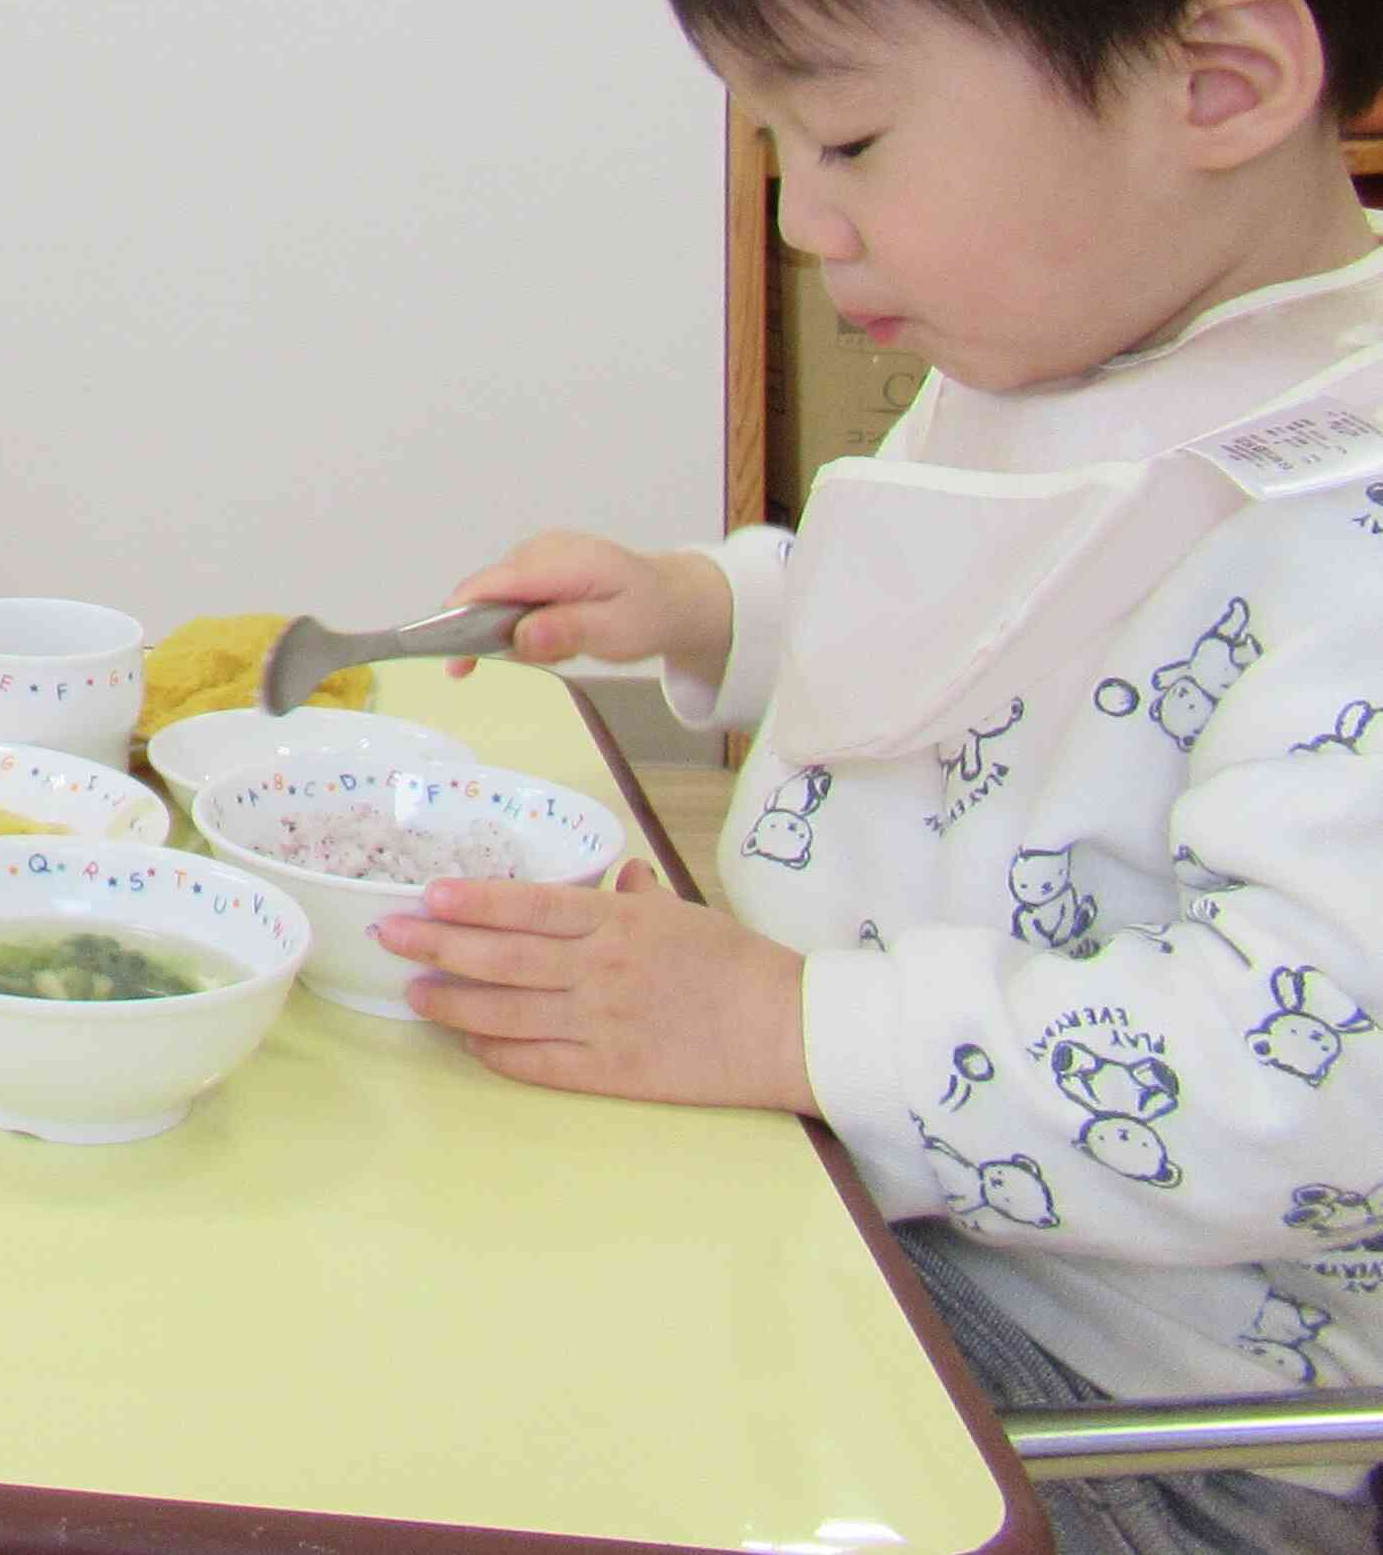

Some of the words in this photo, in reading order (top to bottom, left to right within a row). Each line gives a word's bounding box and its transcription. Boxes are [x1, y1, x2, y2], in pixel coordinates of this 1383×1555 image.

[56, 682, 69, 701] F
[274, 772, 284, 791] B
[339, 773, 357, 791] D
[426, 783, 442, 804] F
[503, 795, 523, 820] H
[546, 798, 556, 817] I
[570, 812, 585, 831] J
[28, 853, 52, 874] Q
[82, 860, 100, 882] R
[129, 872, 145, 892] S
[175, 868, 188, 889] T
[213, 894, 228, 915] U
[252, 893, 265, 915] V
[1109, 1029, 1166, 1054] PLAY
